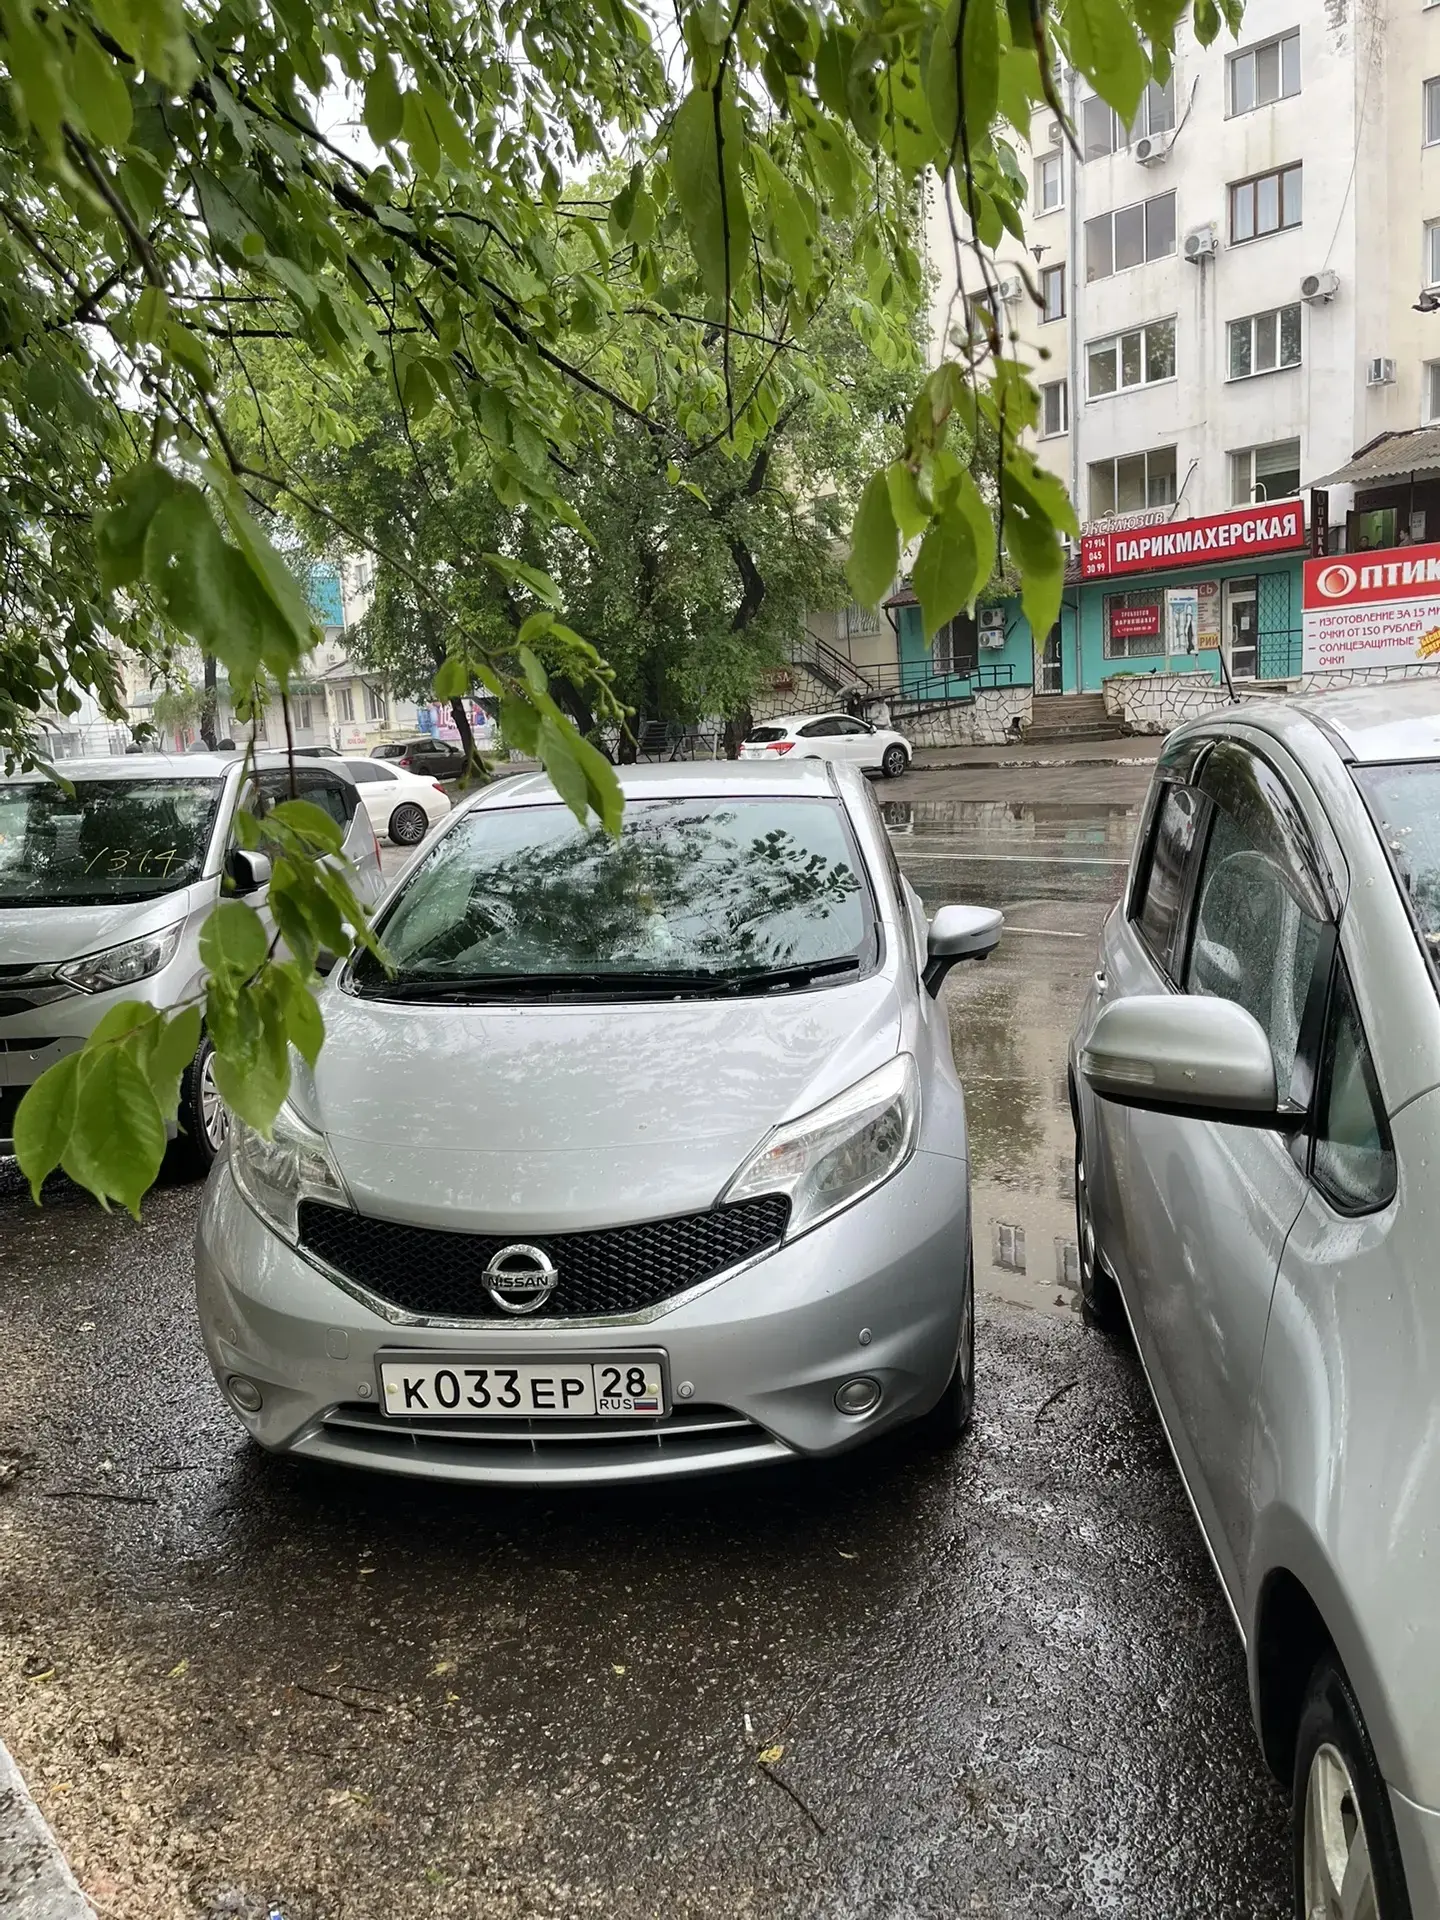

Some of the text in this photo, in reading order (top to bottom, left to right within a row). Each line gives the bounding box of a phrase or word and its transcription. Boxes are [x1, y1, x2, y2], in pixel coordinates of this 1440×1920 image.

[1094, 538, 1106, 548] 914
[1116, 513, 1297, 563] ПАРИКМАХЕРСКАЯ
[1086, 562, 1105, 574] 30 99
[1319, 610, 1395, 628] ИЗГОТОВЛЕНИЕ
[1397, 609, 1411, 619] ЗА
[1414, 607, 1425, 617] 15
[1319, 629, 1345, 640] ОЧКИ
[1347, 628, 1360, 637] ОТ
[1383, 620, 1423, 633] РУБЛЕЙ
[1319, 636, 1414, 652] СОЛНЦЕЗАЩИТНЫЕ
[1319, 655, 1345, 666] ОЧКИ
[487, 1275, 549, 1288] NISSAN
[600, 1367, 647, 1397] 28
[600, 1398, 632, 1410] RUS
